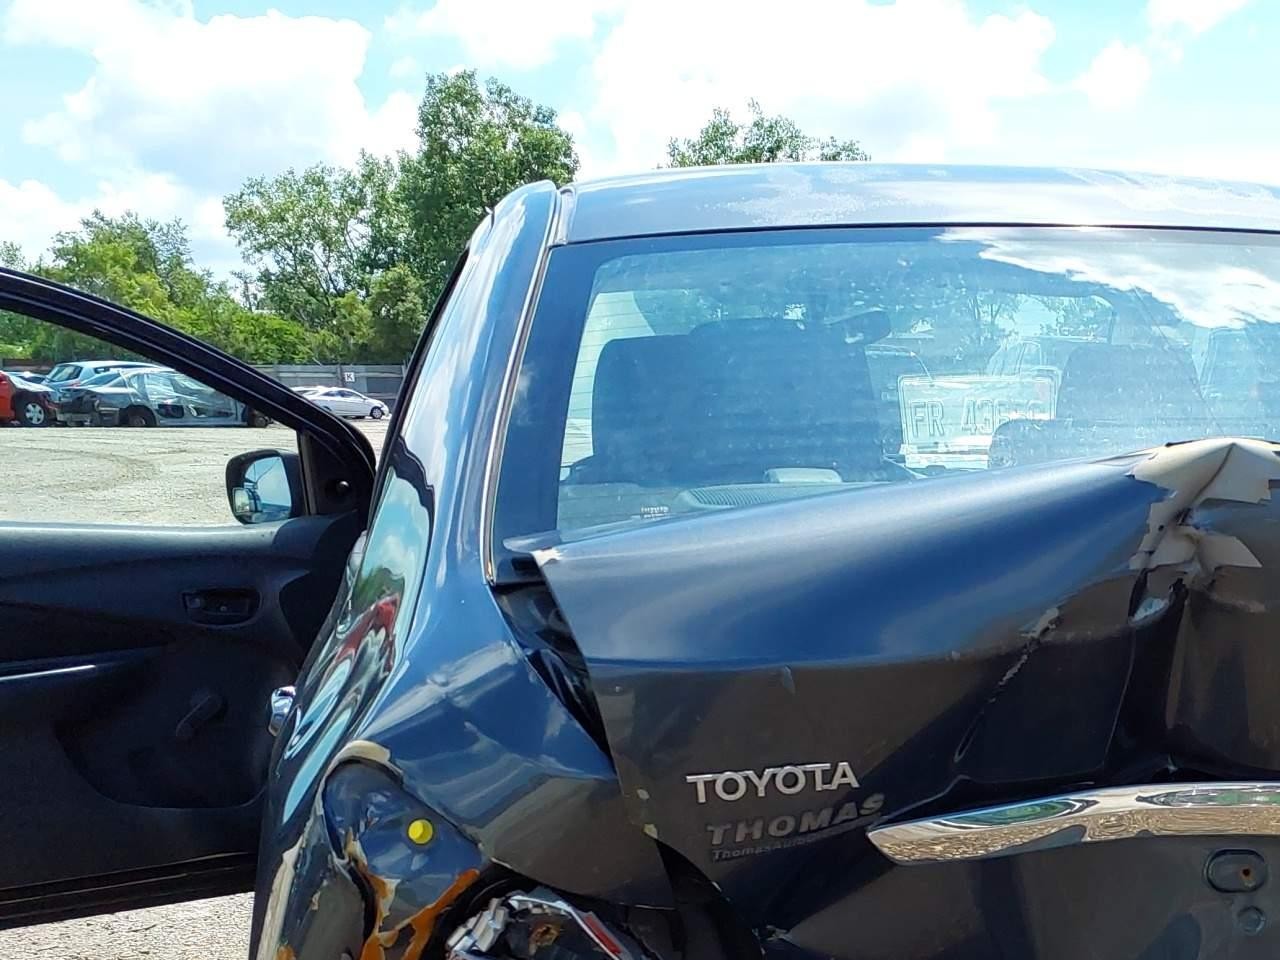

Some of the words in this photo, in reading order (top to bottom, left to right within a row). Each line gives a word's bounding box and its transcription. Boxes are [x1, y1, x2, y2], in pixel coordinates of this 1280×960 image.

[910, 399, 945, 437] FR
[686, 761, 860, 803] TOYOTA
[706, 793, 885, 846] THOMAS
